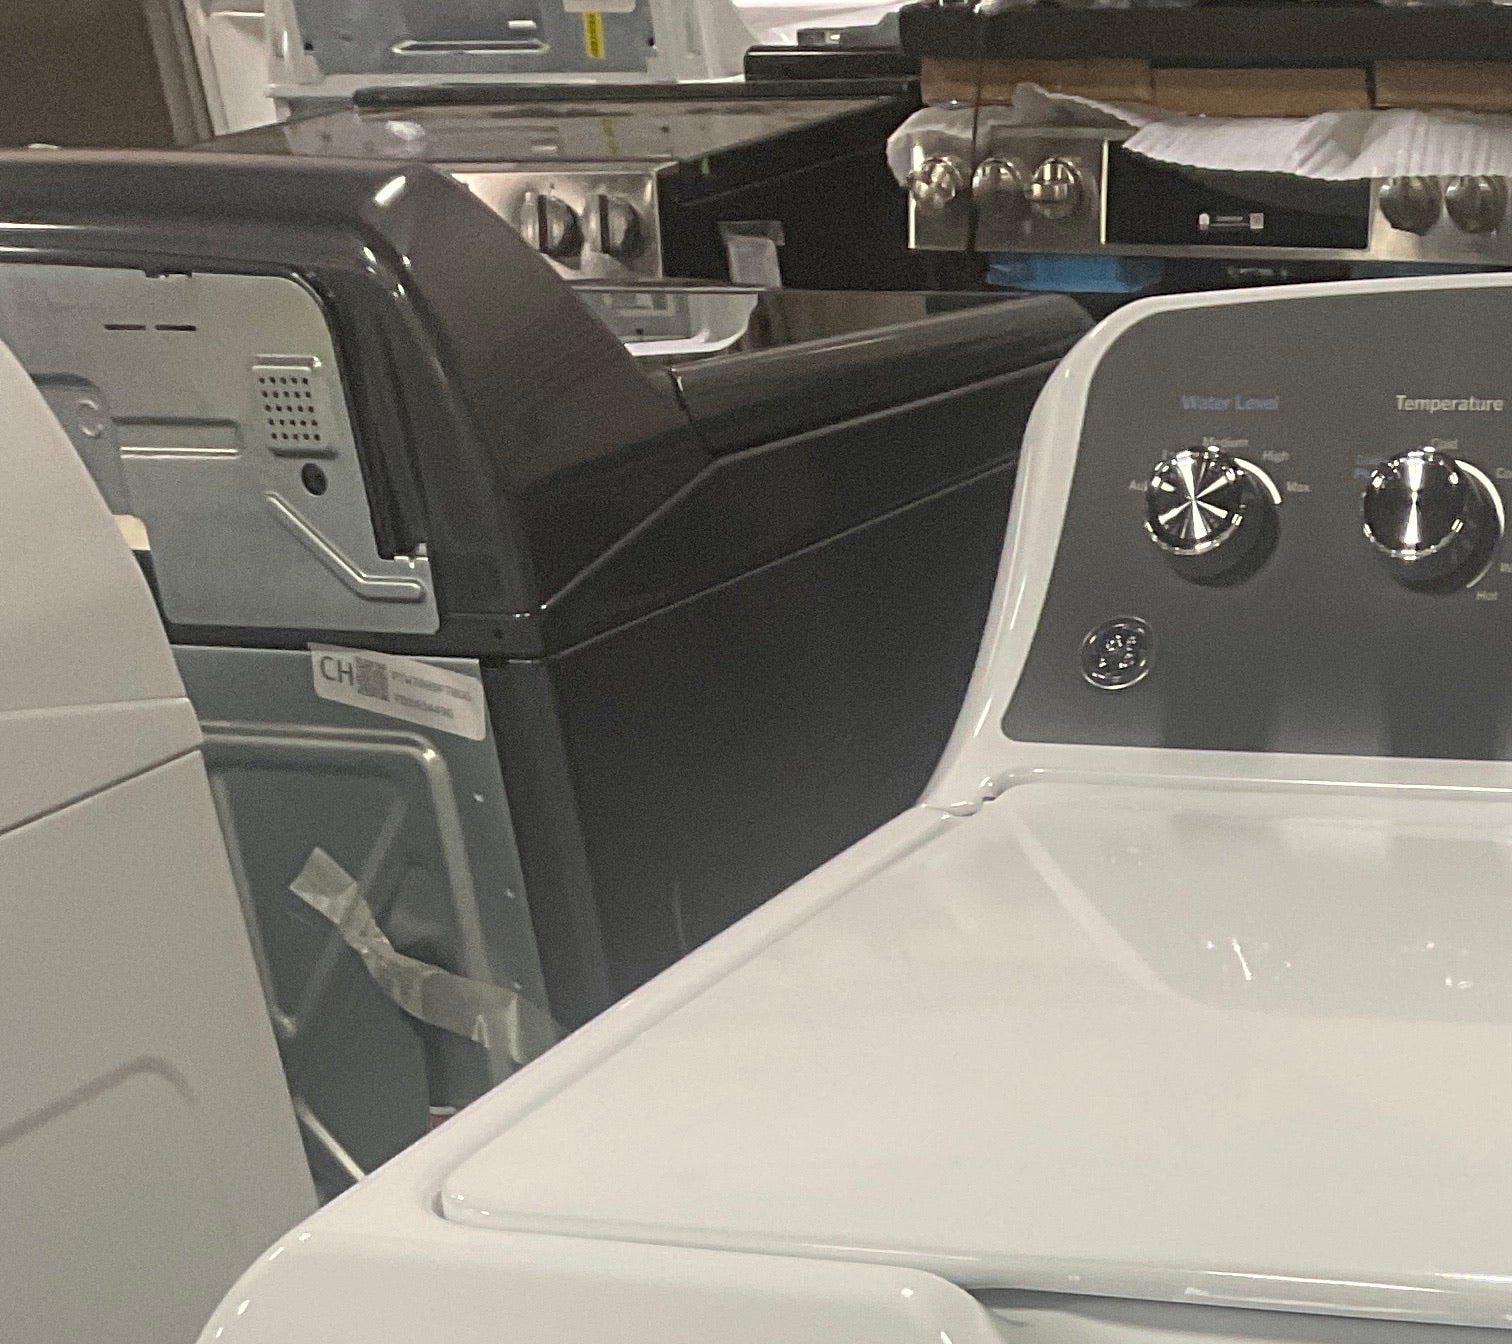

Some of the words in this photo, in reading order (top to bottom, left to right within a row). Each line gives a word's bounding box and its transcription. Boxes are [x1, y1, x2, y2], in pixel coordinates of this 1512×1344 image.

[1182, 395, 1231, 410] Water
[1396, 394, 1504, 413] Temperature
[320, 656, 354, 686] CH
